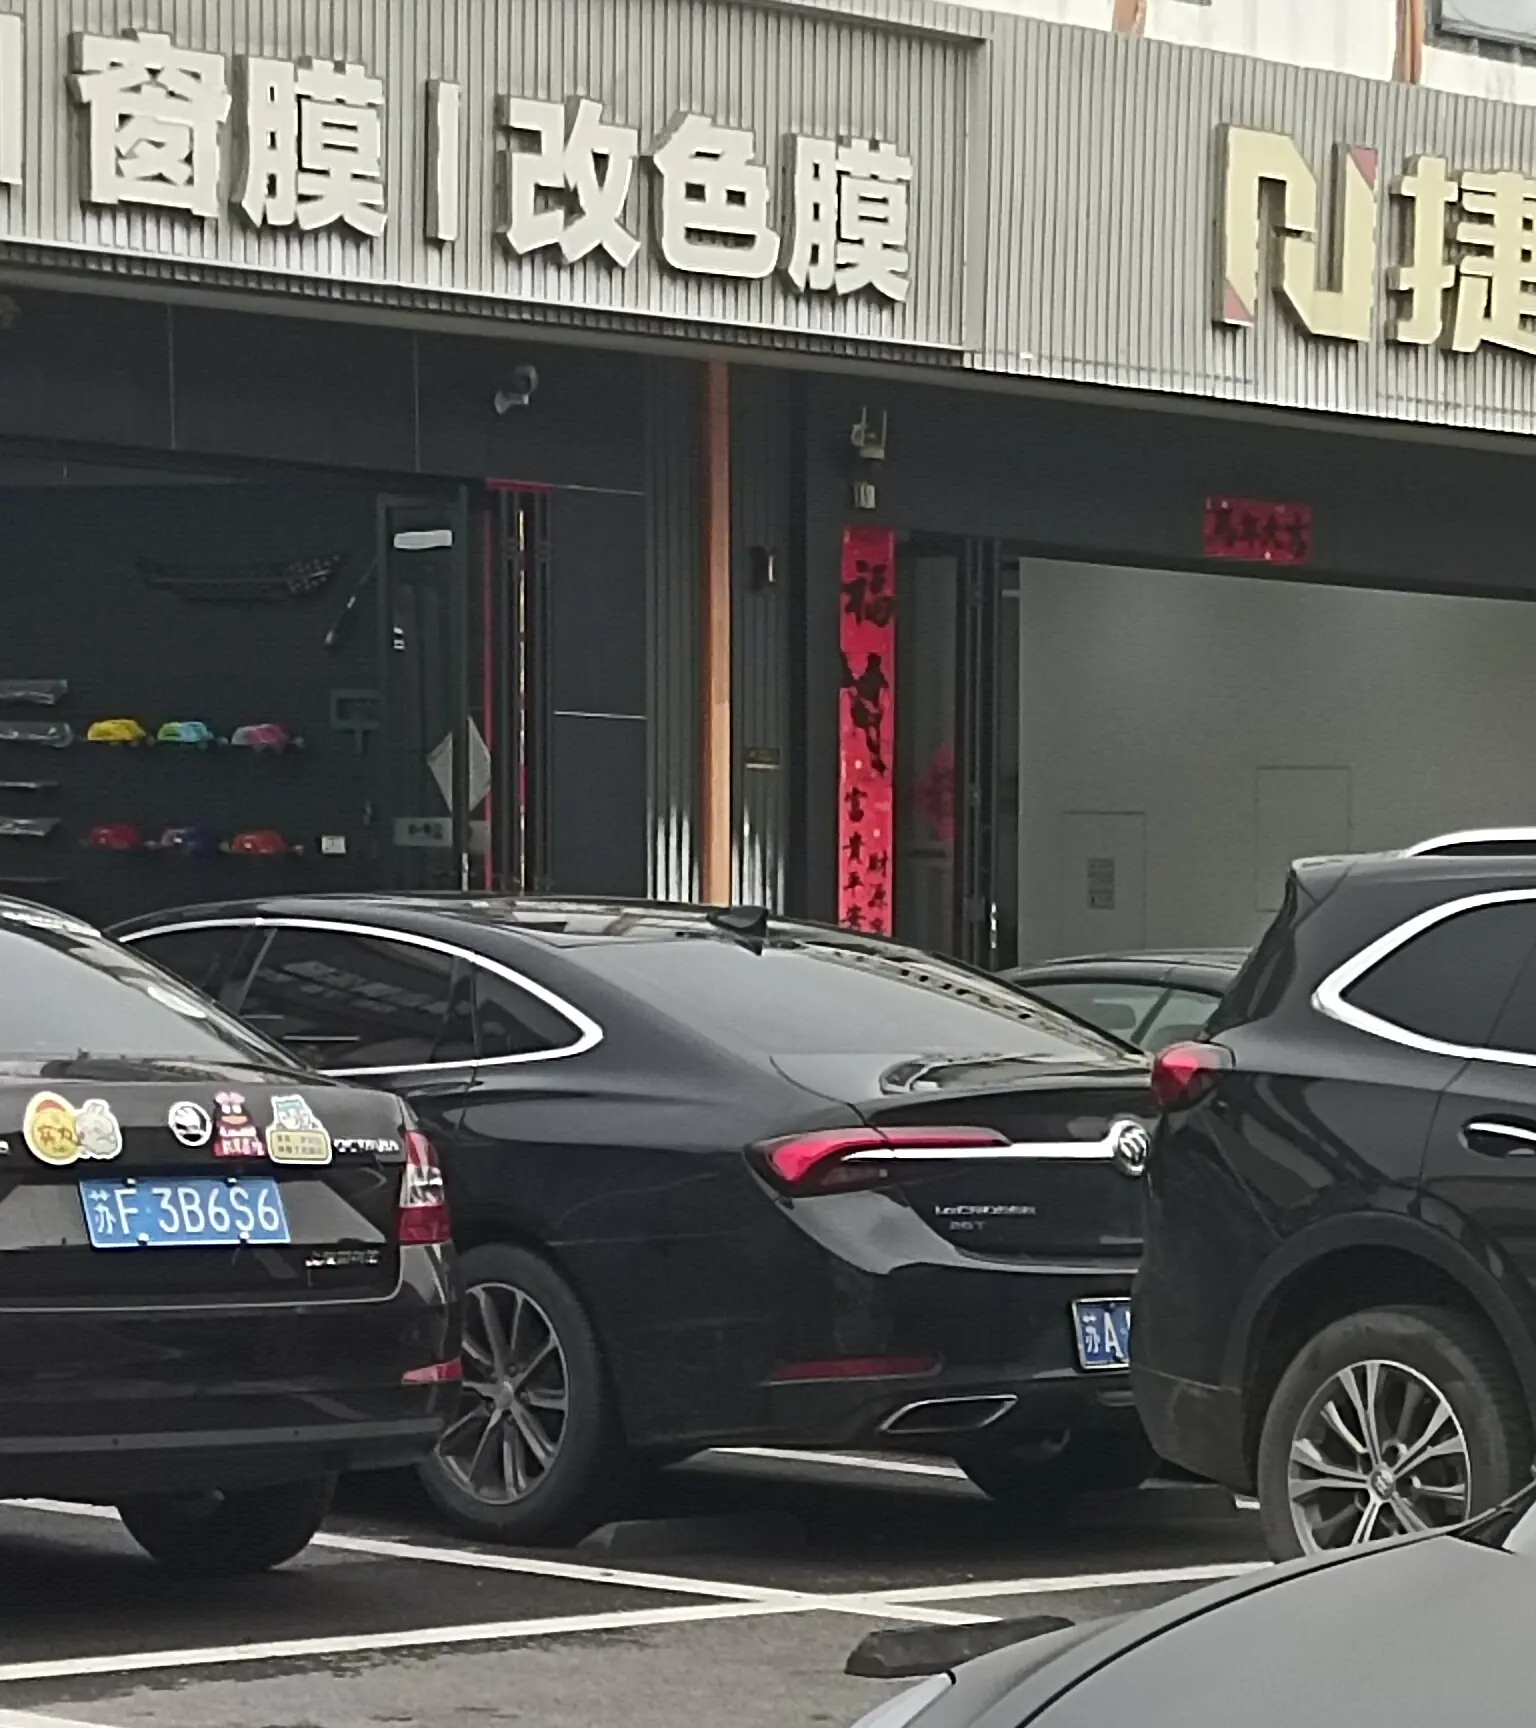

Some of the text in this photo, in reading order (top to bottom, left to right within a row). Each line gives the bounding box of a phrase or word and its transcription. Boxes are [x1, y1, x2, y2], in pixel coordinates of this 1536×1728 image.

[70, 30, 913, 303] 窗膜 改色膜
